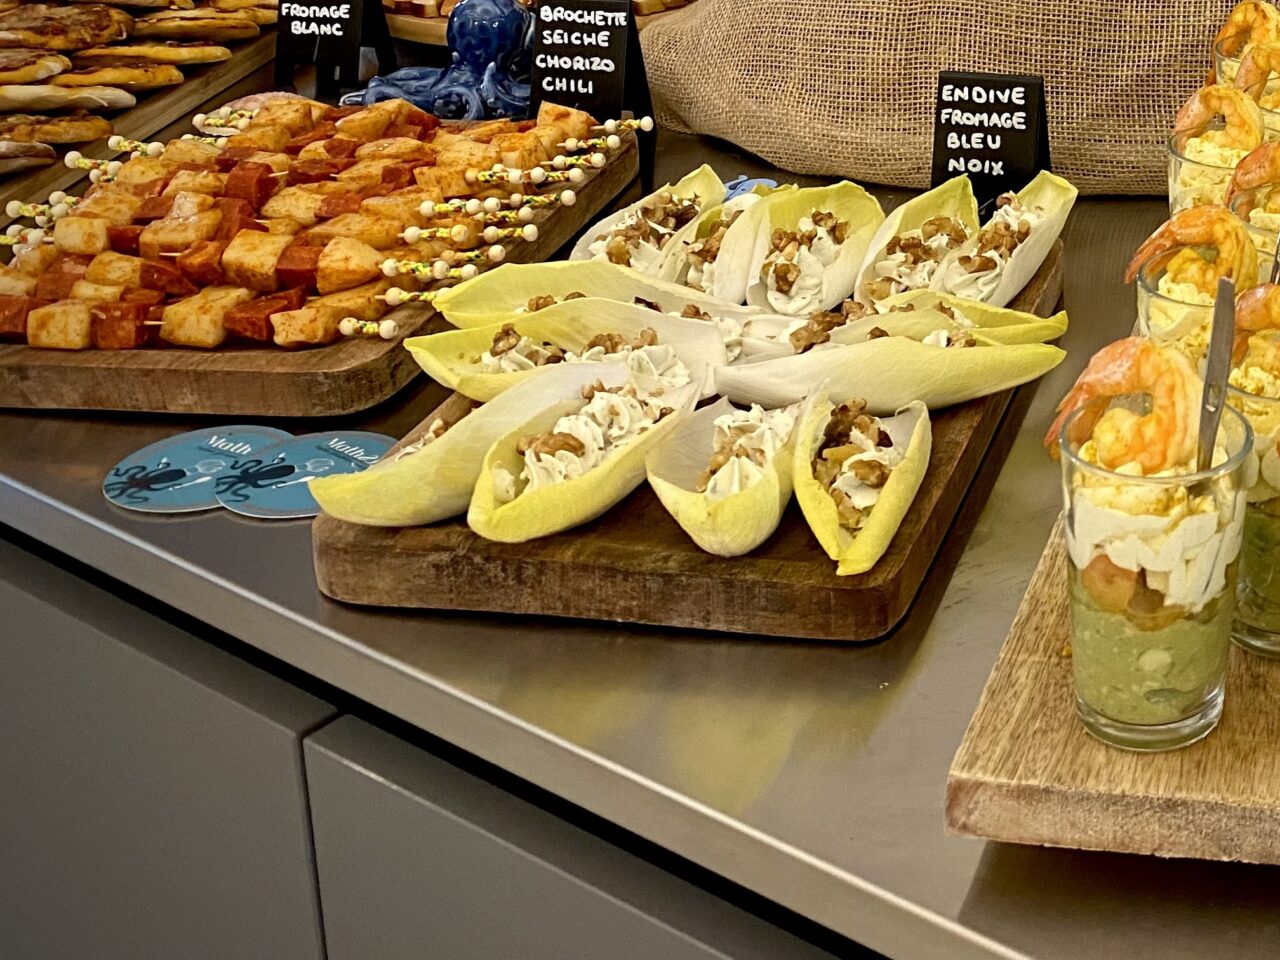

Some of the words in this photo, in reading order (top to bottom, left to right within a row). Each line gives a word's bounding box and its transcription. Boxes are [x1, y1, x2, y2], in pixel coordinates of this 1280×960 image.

[282, 3, 350, 18] FROMAGE
[540, 6, 628, 26] BROCHETTE
[291, 21, 343, 36] BLANC
[542, 30, 611, 47] SEICHE
[535, 54, 615, 72] CHORIZO
[542, 77, 593, 94] CHILI
[942, 85, 1025, 105] ENDIVE
[941, 108, 1026, 130] FROMAGE
[947, 132, 1001, 150] BLEU
[948, 157, 1004, 176] NOIX
